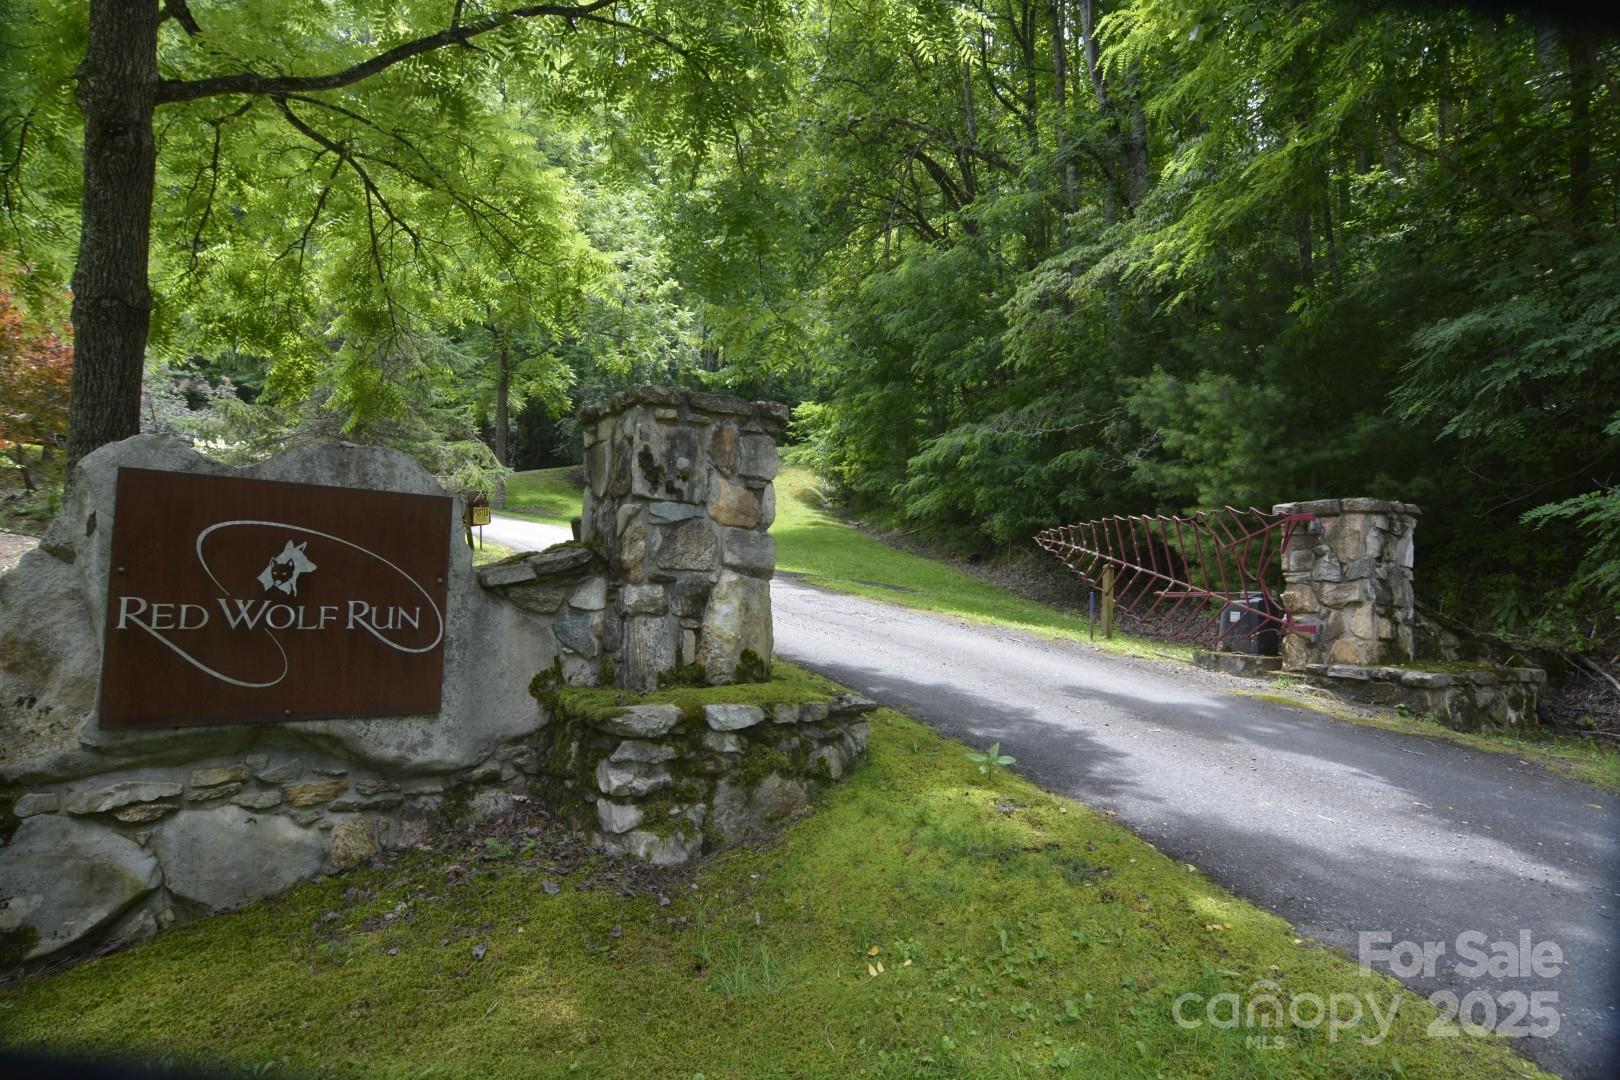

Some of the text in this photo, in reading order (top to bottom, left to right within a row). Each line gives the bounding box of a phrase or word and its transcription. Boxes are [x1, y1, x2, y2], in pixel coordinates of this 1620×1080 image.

[116, 596, 421, 631] RED WOLF RUN
